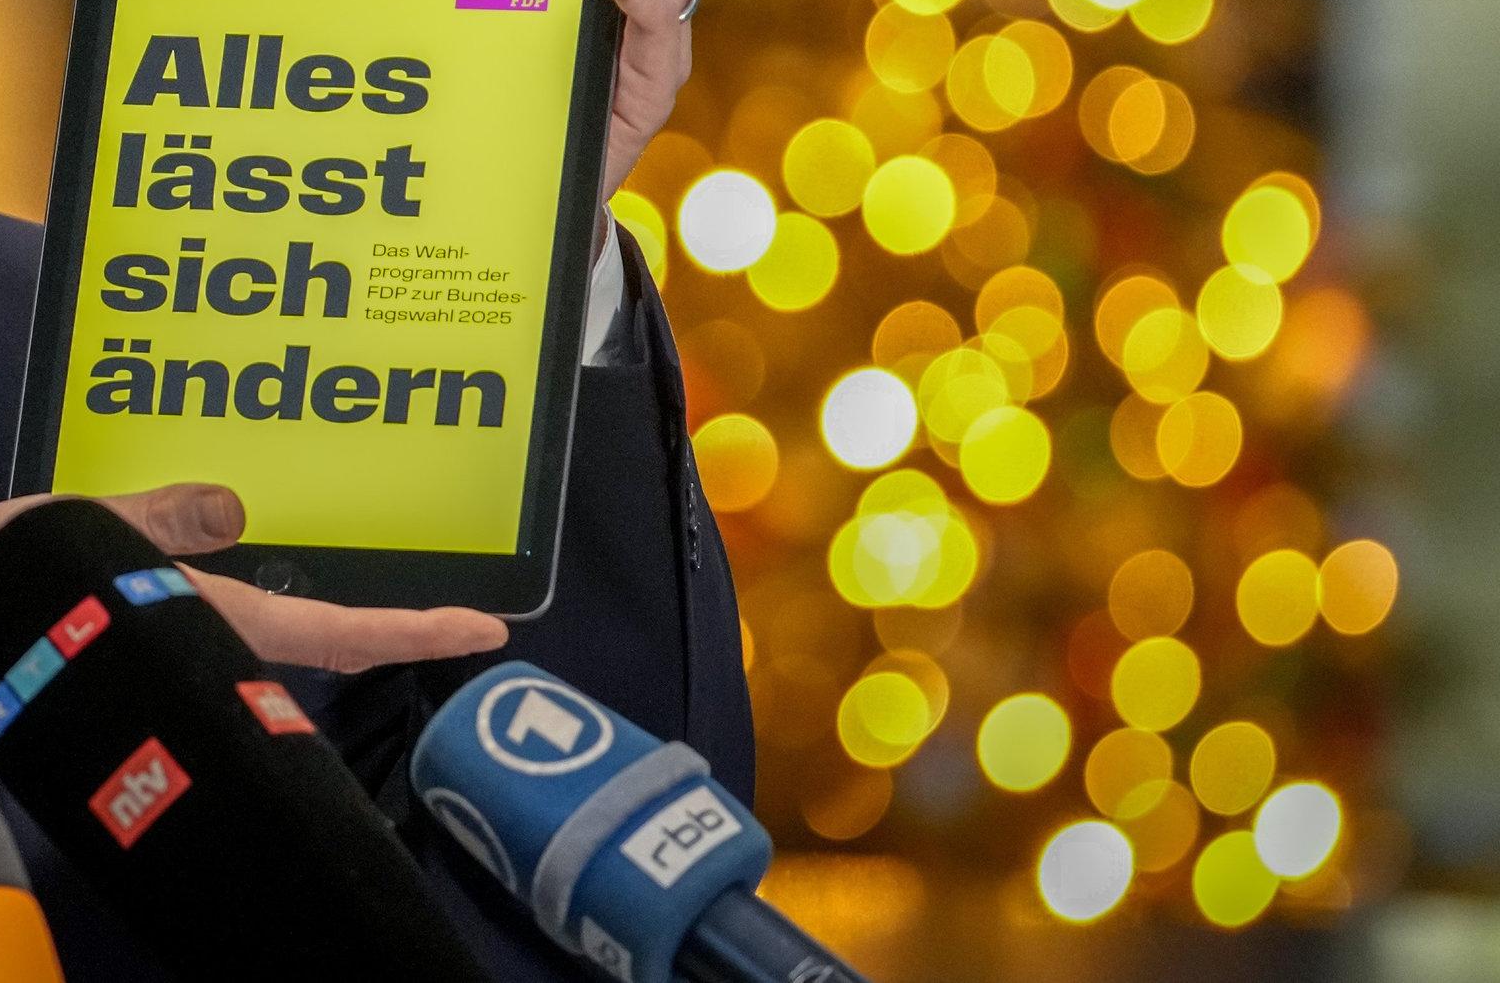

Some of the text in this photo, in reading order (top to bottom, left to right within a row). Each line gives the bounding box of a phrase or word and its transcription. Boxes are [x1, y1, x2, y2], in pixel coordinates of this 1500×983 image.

[121, 33, 432, 115] Alles
[111, 132, 426, 218] lässt
[100, 236, 352, 319] sich
[369, 266, 511, 283] programm der
[372, 243, 470, 260] Das Wahl-
[364, 307, 512, 325] tagswahl 2025
[367, 285, 527, 304] FDP zur Bundes-
[85, 337, 507, 429] ändern
[108, 758, 169, 831] ntv
[651, 807, 725, 869] rbb
